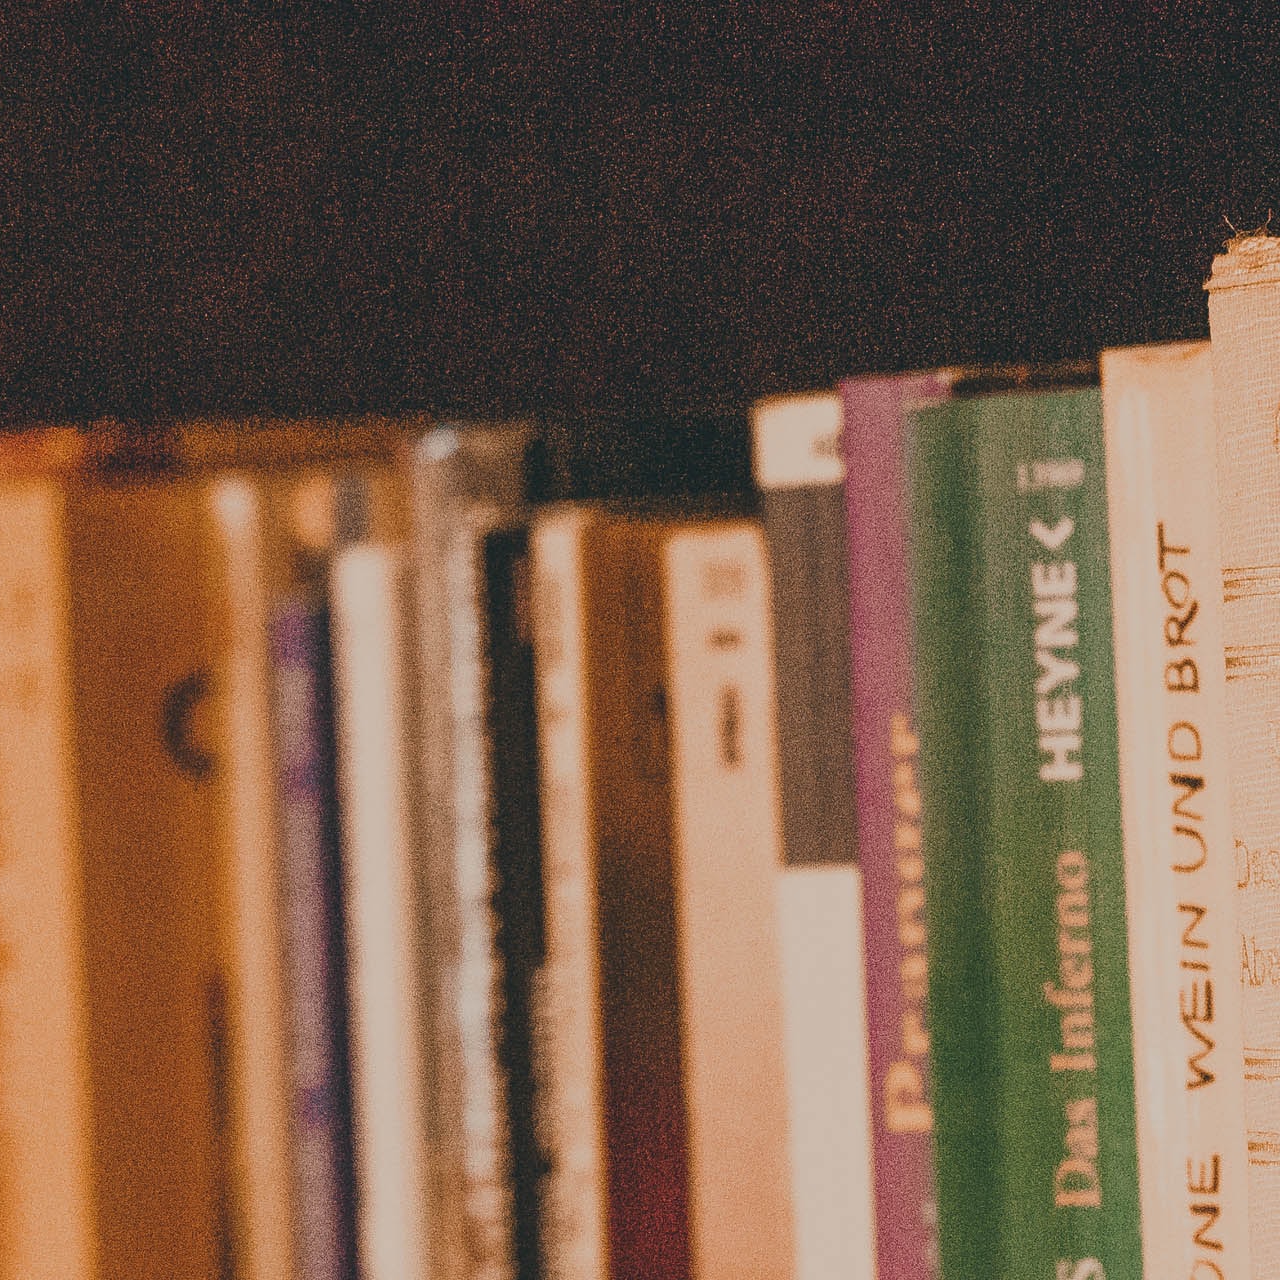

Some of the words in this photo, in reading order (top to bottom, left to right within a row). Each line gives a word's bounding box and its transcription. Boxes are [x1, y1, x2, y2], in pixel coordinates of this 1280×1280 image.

[1029, 562, 1084, 783] HEYNE
[1156, 520, 1200, 693] BROT
[1167, 720, 1209, 874] UND
[1044, 848, 1098, 1075] Inferno
[1178, 902, 1217, 1092] WEIN
[1054, 1095, 1102, 1209] Das
